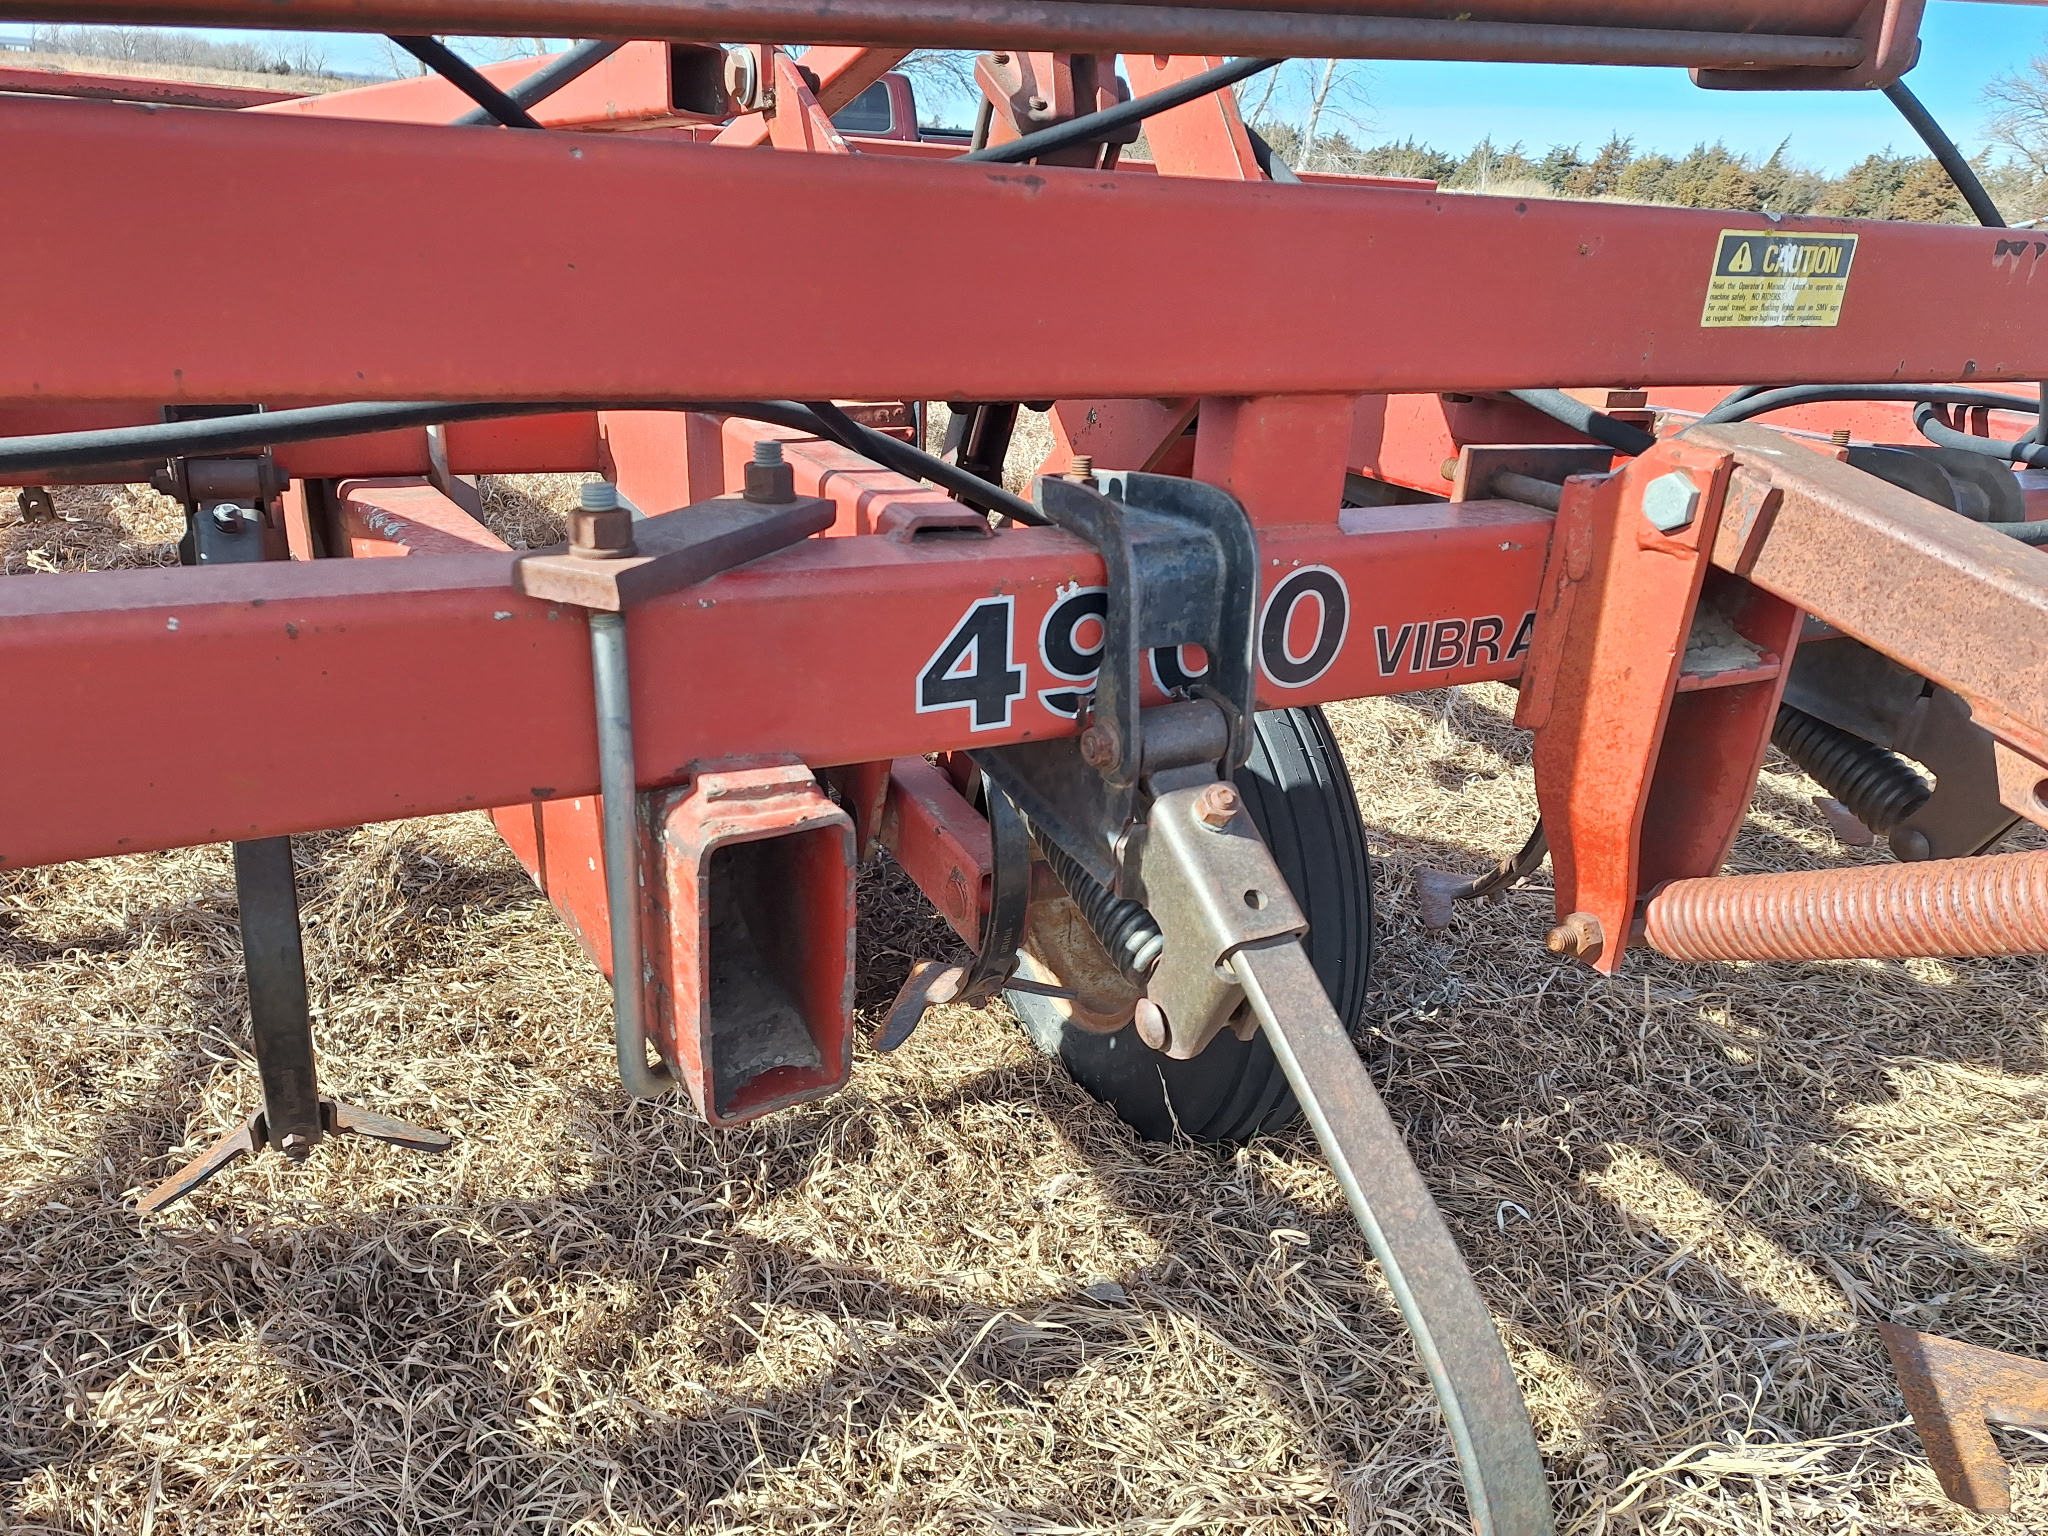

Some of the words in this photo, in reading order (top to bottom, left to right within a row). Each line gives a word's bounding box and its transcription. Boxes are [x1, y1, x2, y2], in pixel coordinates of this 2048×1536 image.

[1763, 245, 1843, 274] CAUTION
[1712, 282, 1725, 290] Read
[1727, 282, 1736, 290] the
[1738, 282, 1764, 292] Operator's
[1815, 283, 1833, 292] operate
[1835, 283, 1844, 291] this
[1751, 293, 1760, 301] NO
[1707, 303, 1715, 311] For
[1717, 303, 1729, 311] road
[1816, 303, 1828, 311] SMV
